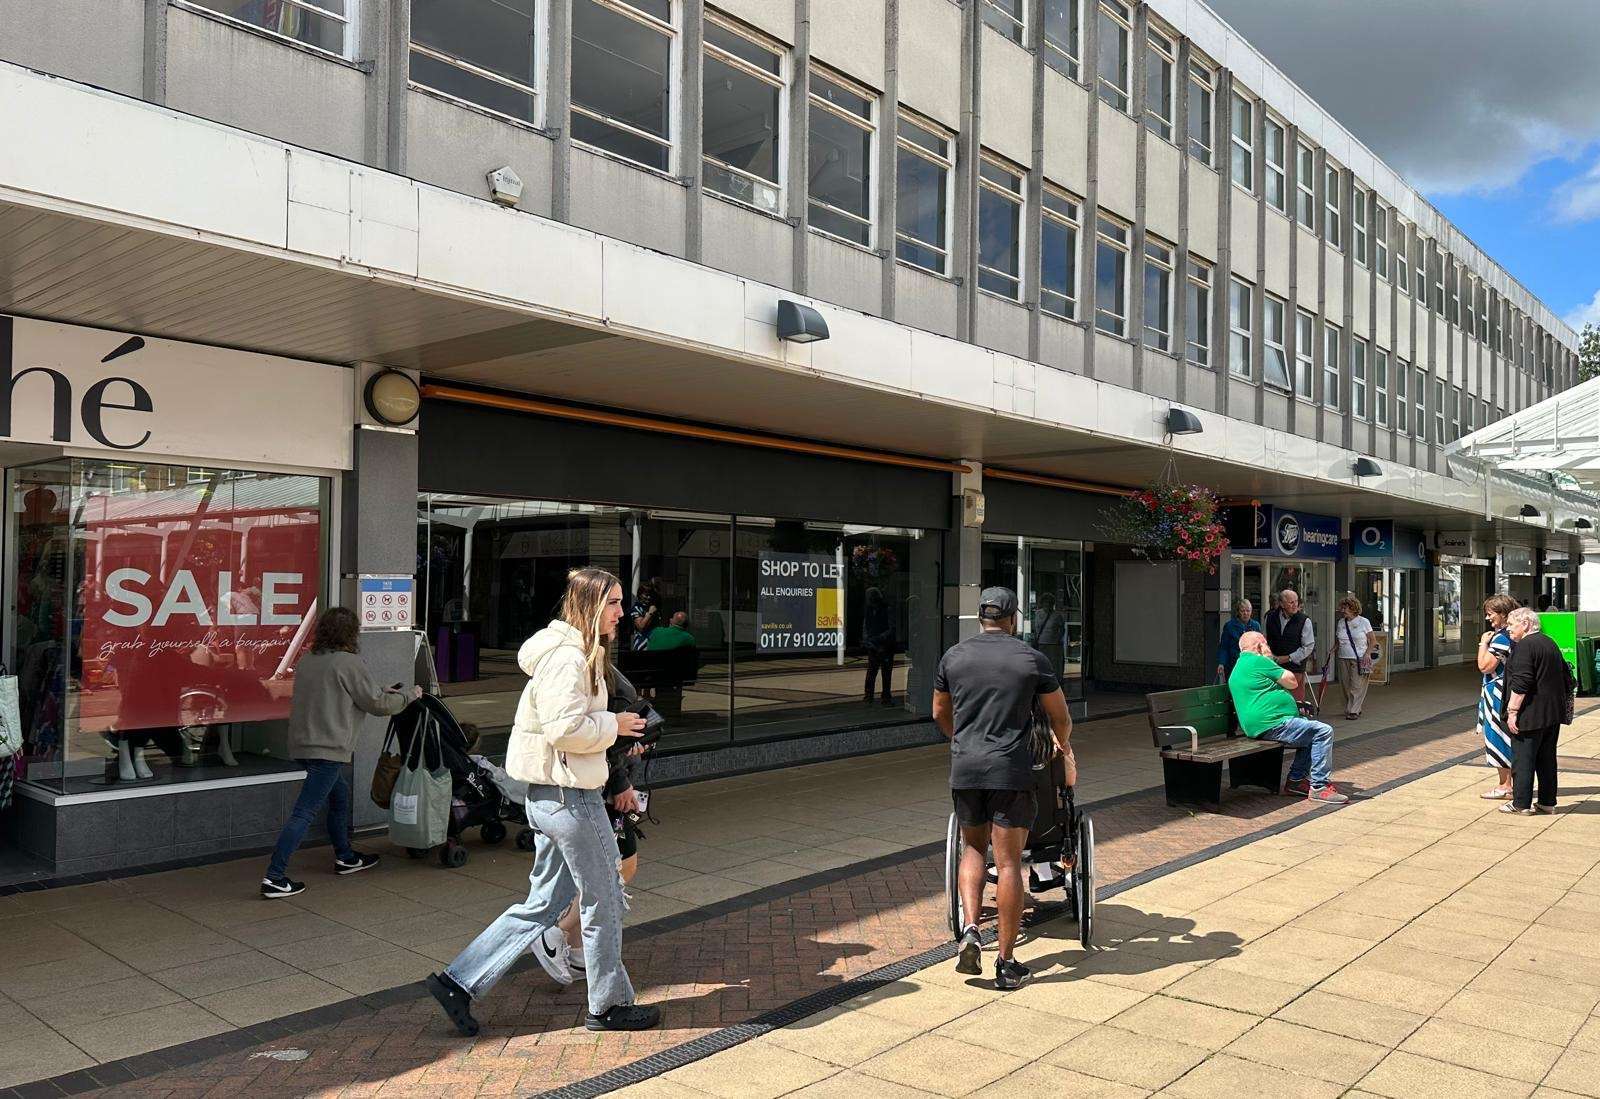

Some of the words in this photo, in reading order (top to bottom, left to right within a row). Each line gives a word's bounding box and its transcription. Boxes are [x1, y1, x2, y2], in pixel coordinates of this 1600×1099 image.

[1303, 528, 1338, 547] hearingcare
[761, 560, 799, 577] SHOP
[802, 562, 819, 578] TO
[823, 563, 844, 579] LET
[102, 567, 303, 628] SALE
[760, 587, 774, 596] ALL
[776, 587, 813, 597] ENQUIRIES
[100, 633, 145, 660] grab
[150, 632, 217, 657] yourself
[219, 638, 233, 649] a
[760, 633, 791, 648] 0117
[793, 632, 814, 647] 910
[817, 632, 844, 647] 2200
